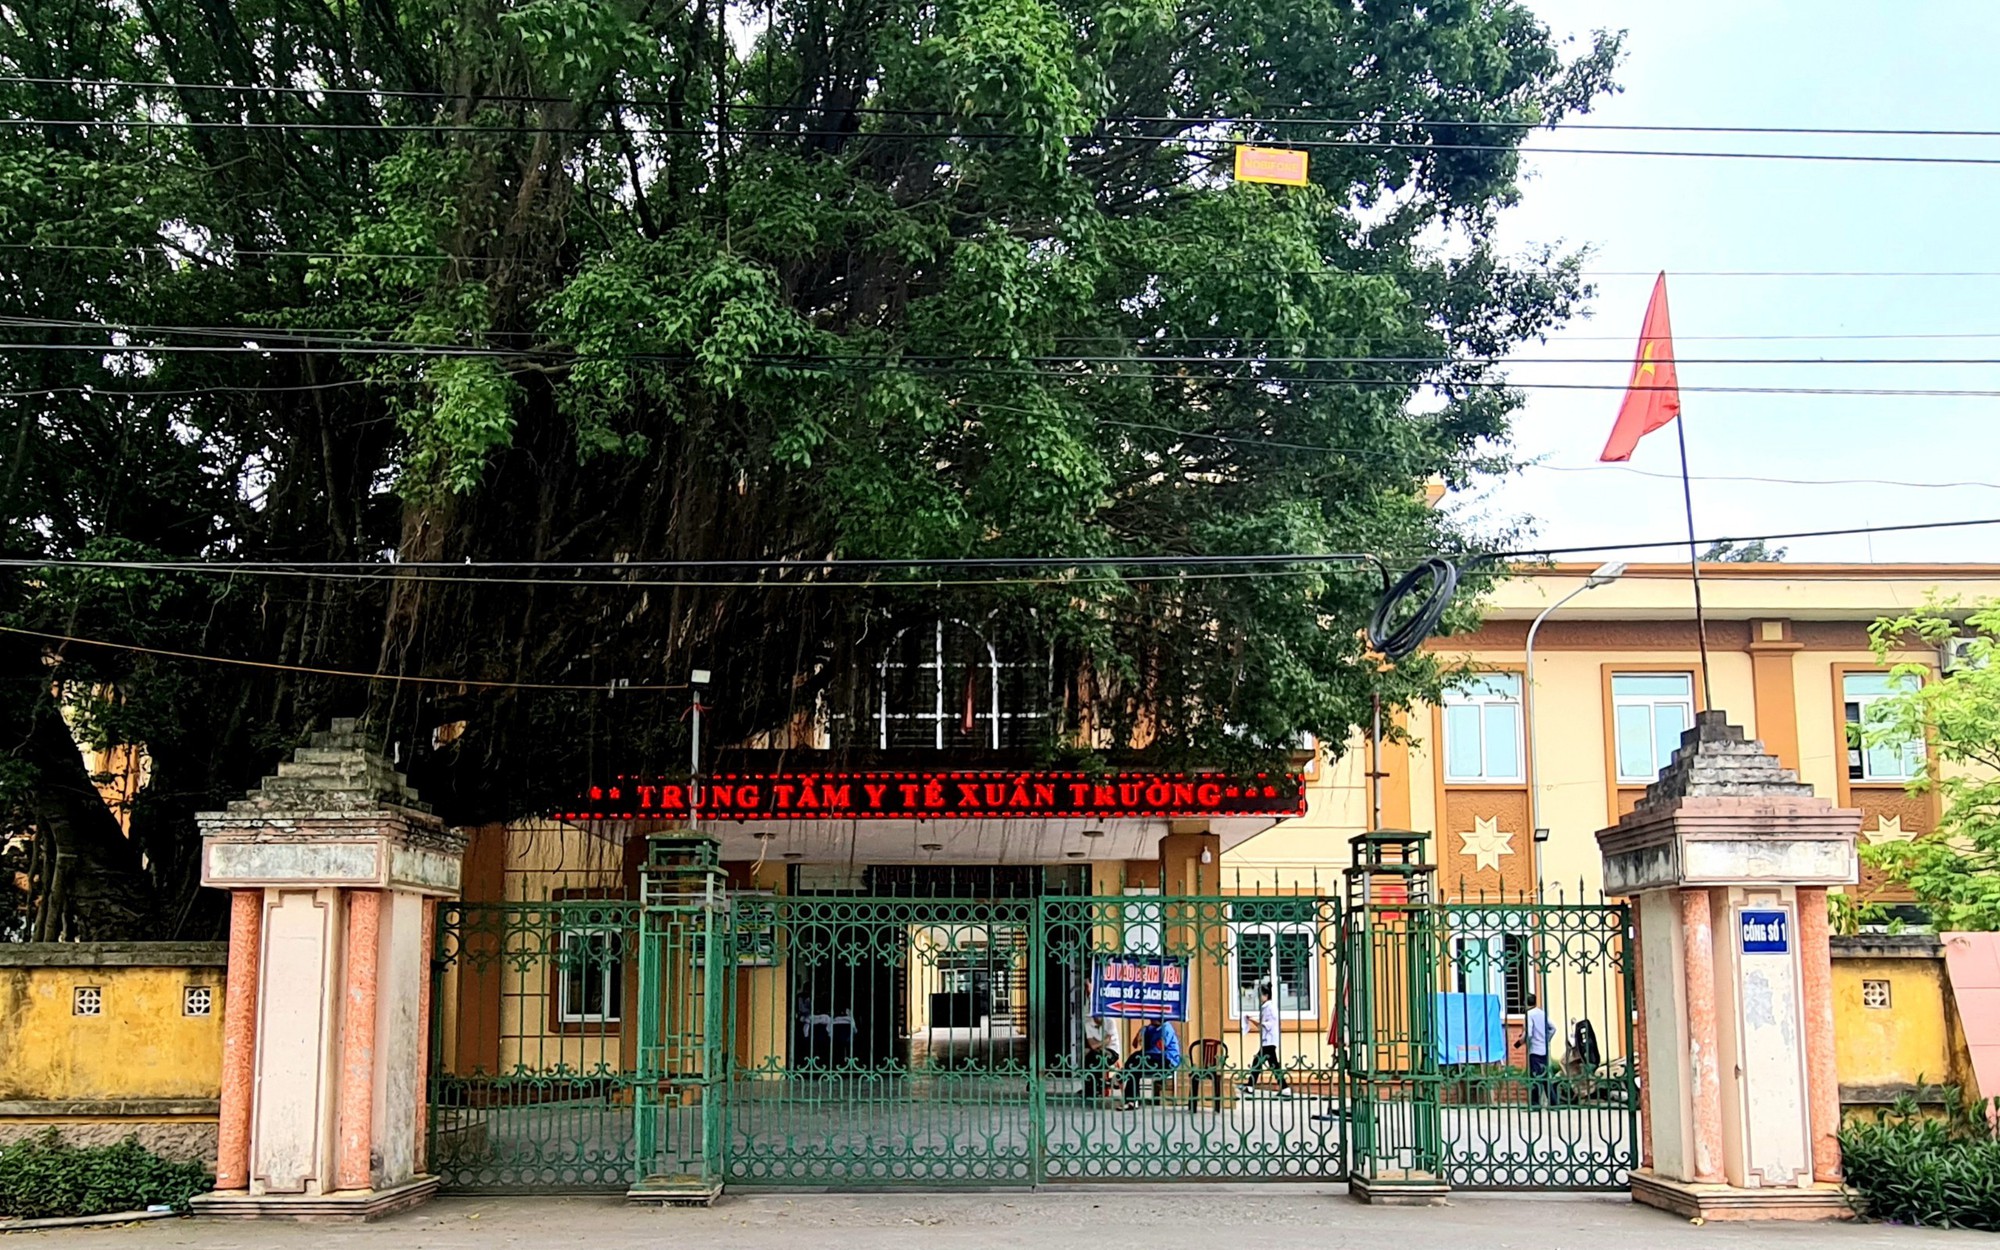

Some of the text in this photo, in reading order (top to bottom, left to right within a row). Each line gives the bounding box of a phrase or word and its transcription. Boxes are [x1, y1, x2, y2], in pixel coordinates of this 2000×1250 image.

[637, 785, 760, 808] TRUNG
[773, 777, 851, 808] TÂM
[864, 784, 887, 807] Y
[1069, 778, 1222, 807] TRƯỜNG
[1767, 917, 1780, 942] SỐ
[1780, 922, 1786, 942] 1
[1122, 985, 1134, 999] SỐ
[1134, 988, 1141, 999] 2
